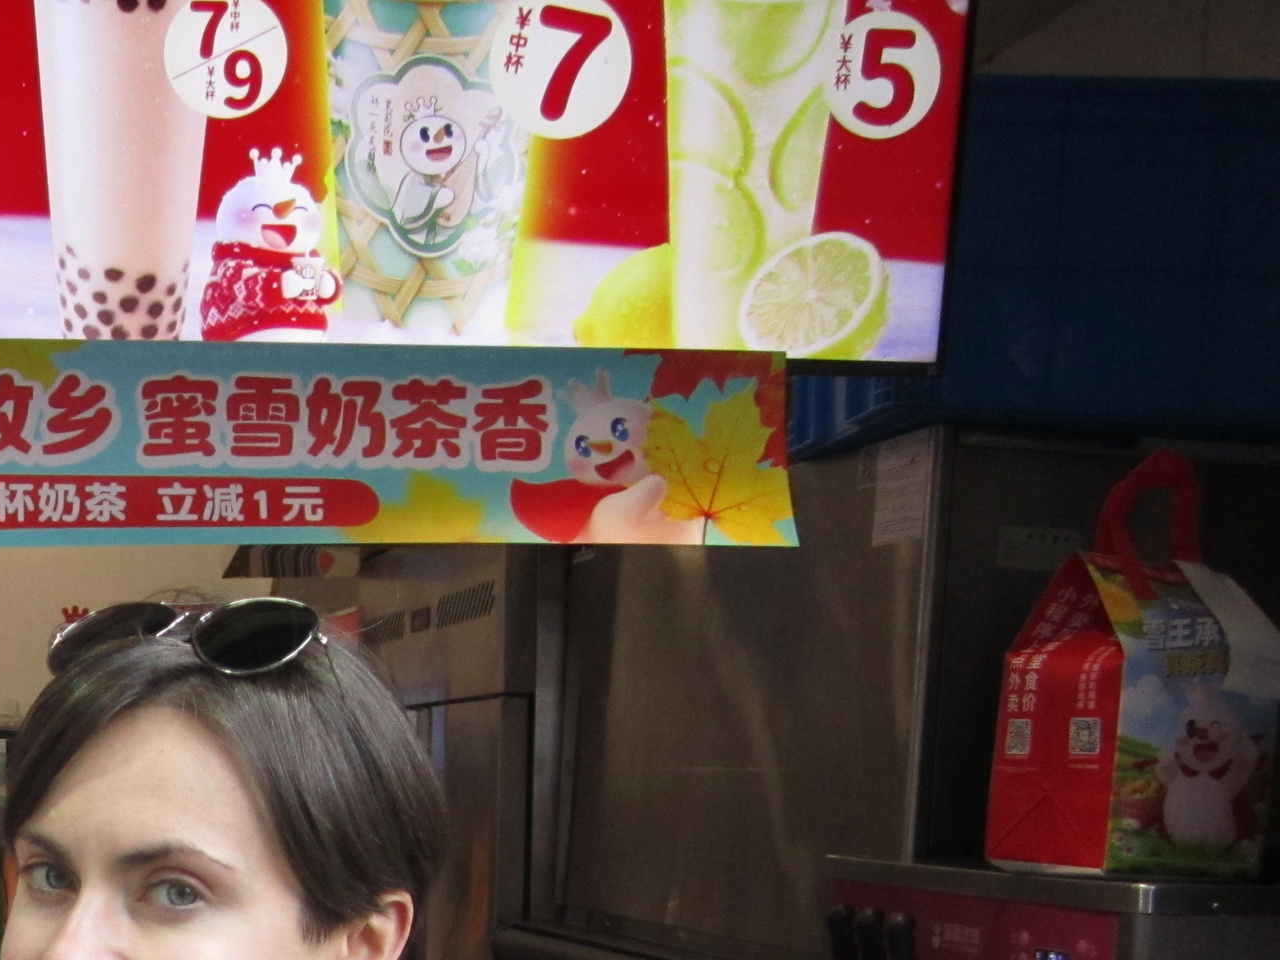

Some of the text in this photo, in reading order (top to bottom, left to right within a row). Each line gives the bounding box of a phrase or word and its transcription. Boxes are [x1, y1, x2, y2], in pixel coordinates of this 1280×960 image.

[223, 50, 263, 109] 9
[539, 5, 613, 122] 7
[852, 28, 916, 126] 5
[140, 376, 549, 461] 蜜雪奶茶香
[157, 482, 325, 522] 立减1元
